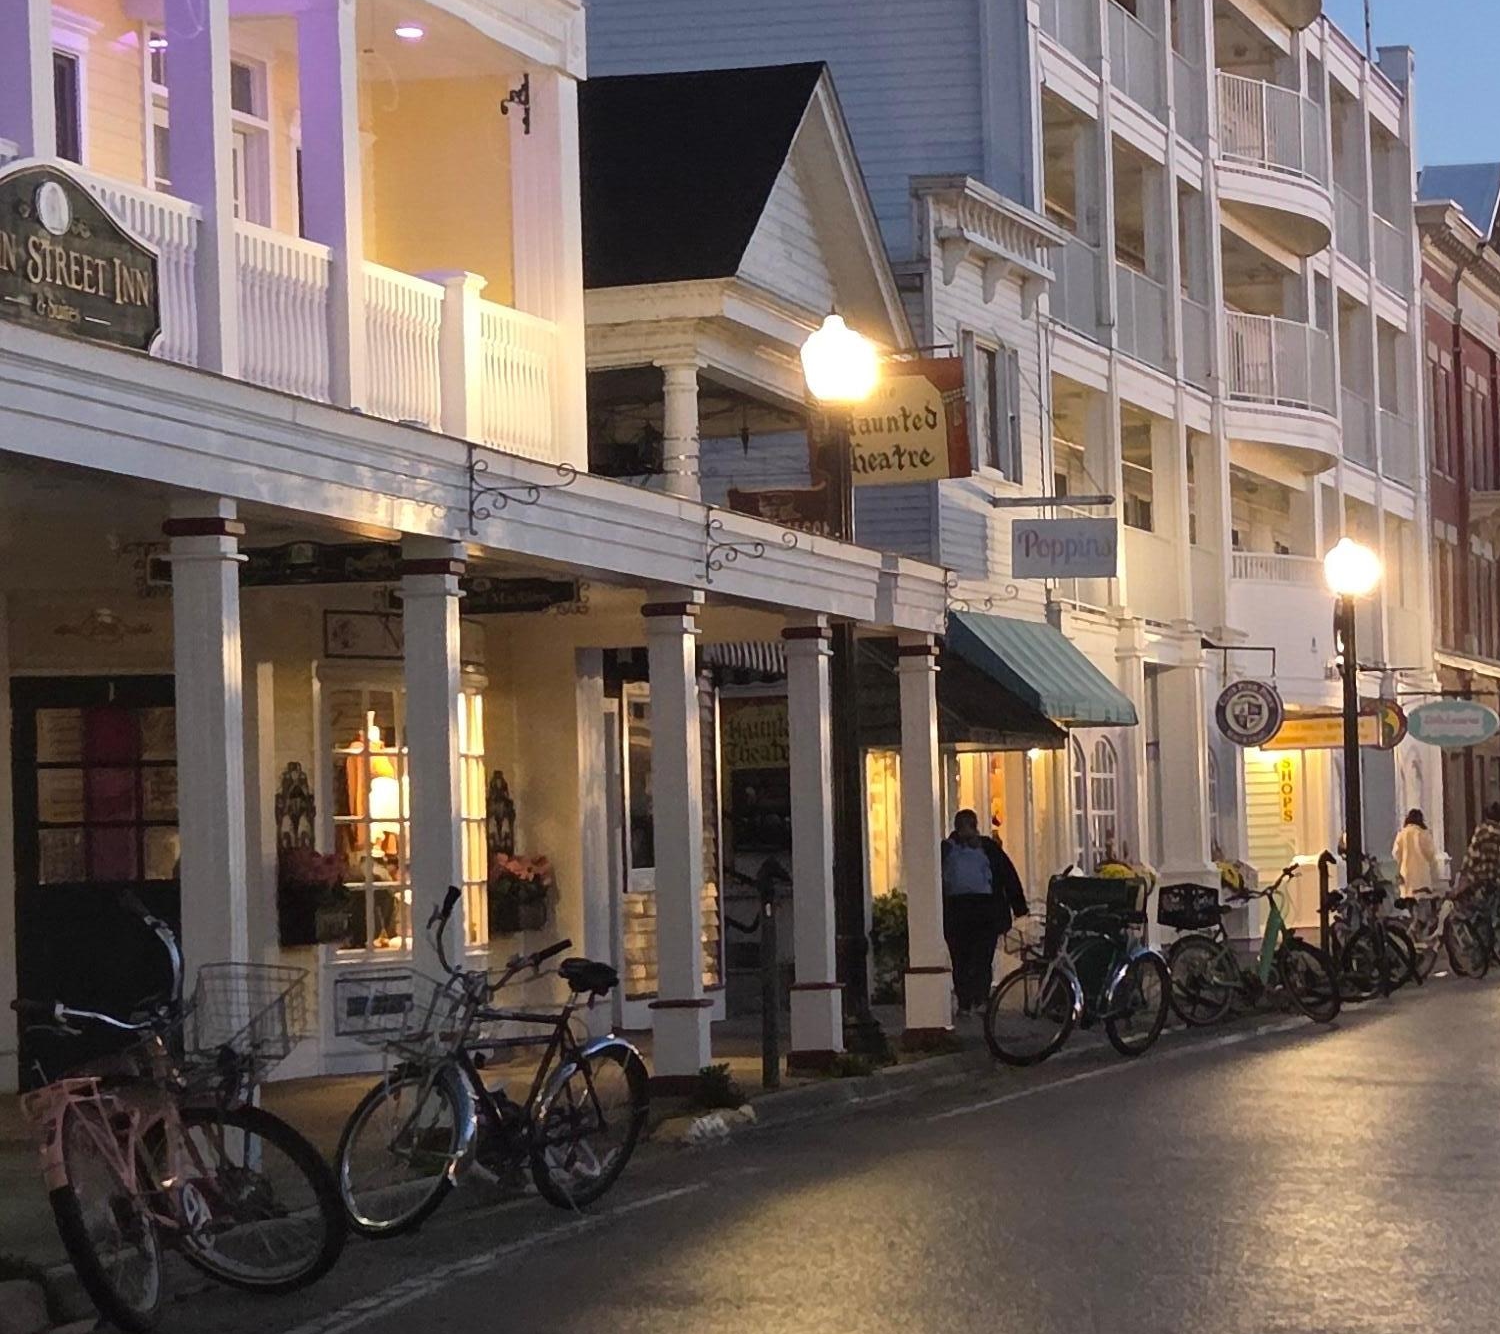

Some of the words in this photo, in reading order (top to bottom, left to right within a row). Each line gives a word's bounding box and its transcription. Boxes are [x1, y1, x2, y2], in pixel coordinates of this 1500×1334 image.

[27, 235, 108, 296] STREET
[113, 258, 149, 307] INN
[851, 444, 936, 474] heatre
[1018, 528, 1112, 565] Poppins
[1280, 757, 1294, 823] SHOPS
